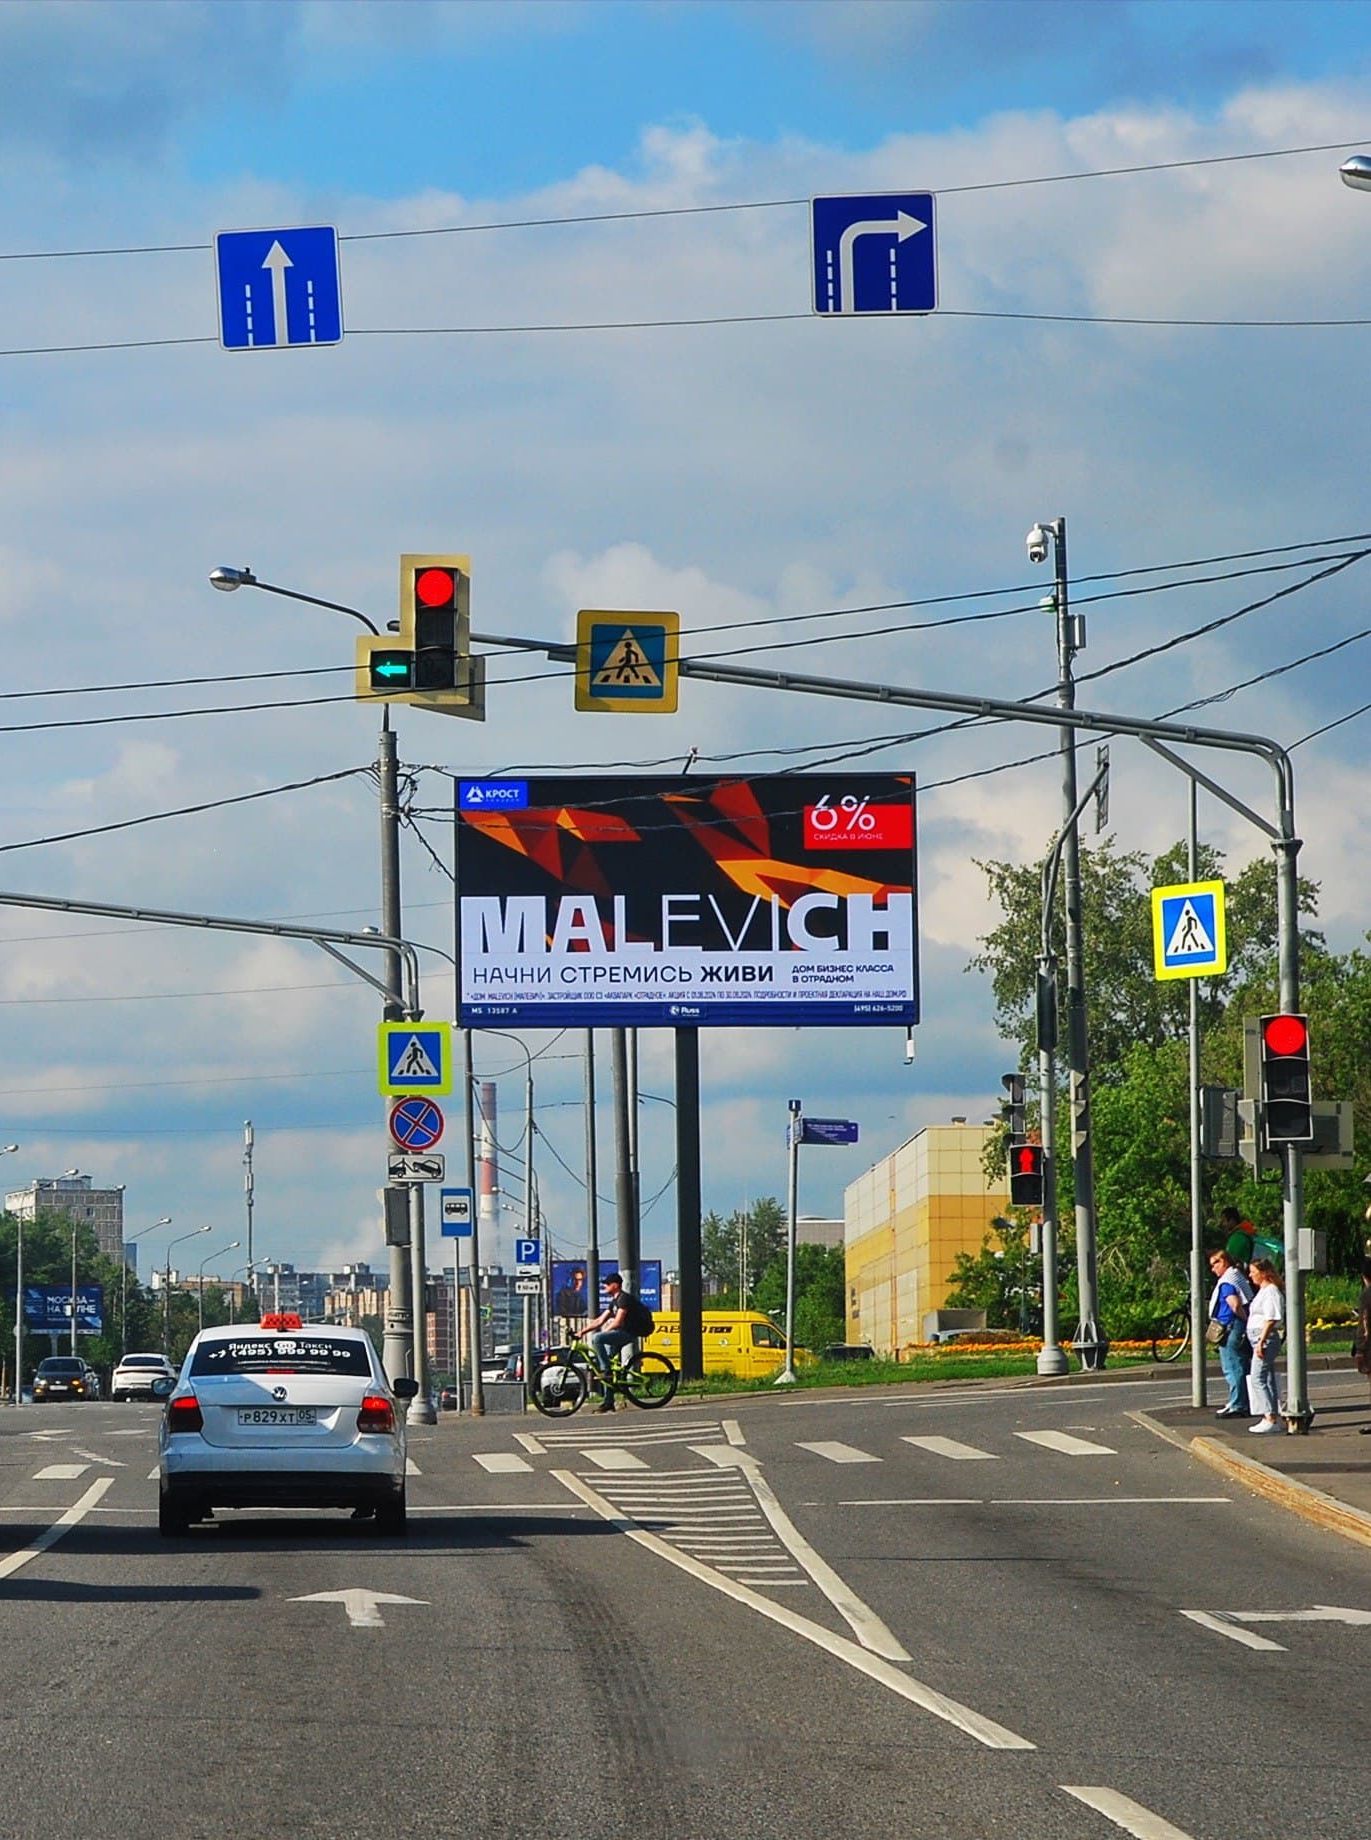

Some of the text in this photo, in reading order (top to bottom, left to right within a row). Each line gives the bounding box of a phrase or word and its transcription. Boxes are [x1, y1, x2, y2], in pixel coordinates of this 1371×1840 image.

[485, 789, 519, 798] КРОСТ
[811, 794, 875, 831] 6%
[460, 892, 913, 952] MALEVICH
[792, 964, 894, 974] ДОМ БИЗНЕС КЛАССА
[472, 965, 774, 984] НАЧНИ СТРЕМИСЬ ЖИВИ
[801, 975, 855, 984] ОТРАДНОМ
[228, 1342, 270, 1350] Яндекс
[300, 1341, 333, 1350] Такси
